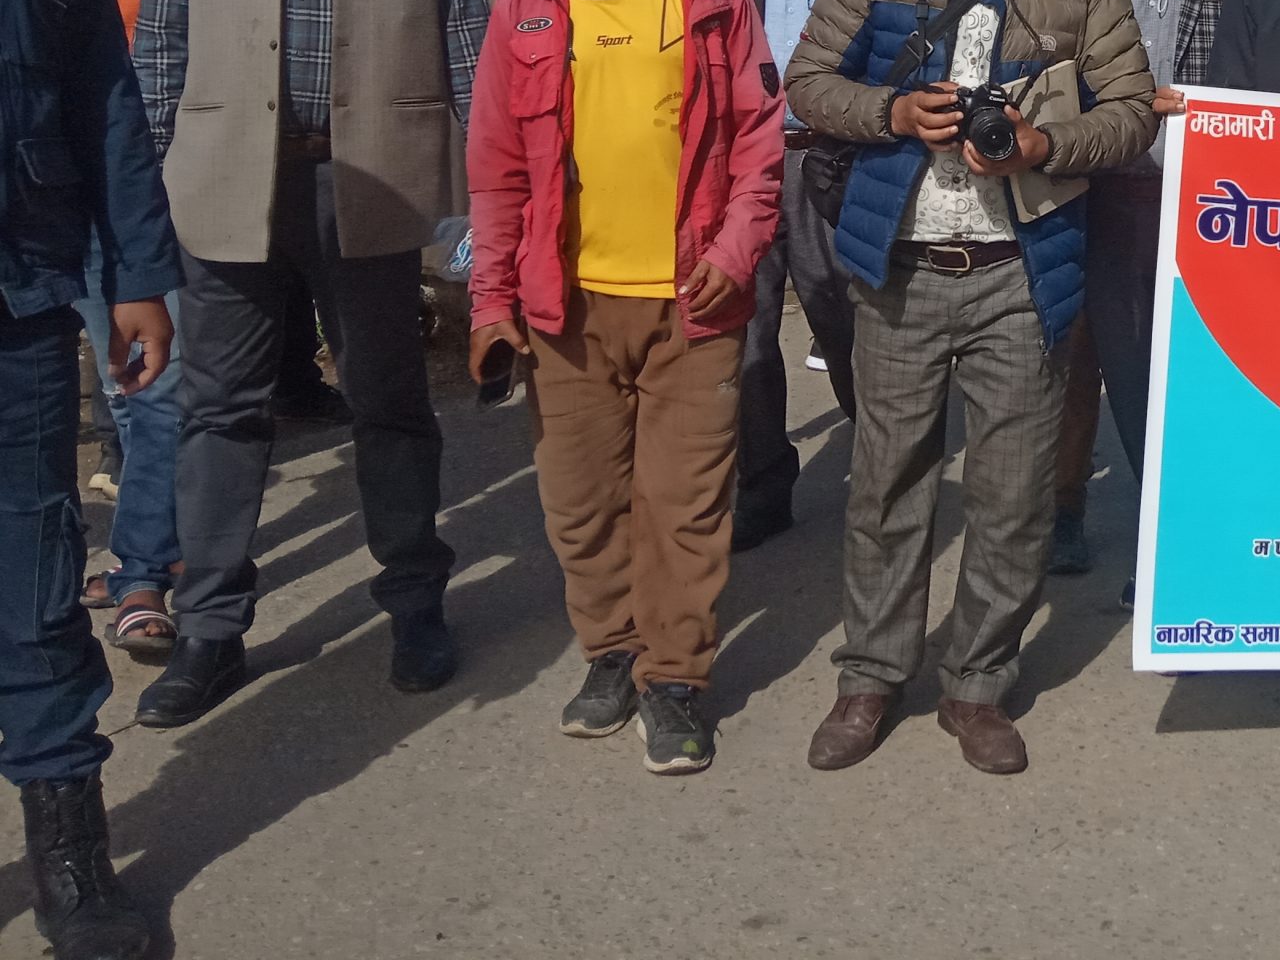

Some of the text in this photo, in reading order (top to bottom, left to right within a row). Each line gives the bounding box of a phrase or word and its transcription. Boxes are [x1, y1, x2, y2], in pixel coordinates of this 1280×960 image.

[596, 35, 633, 48] Sport
[1190, 110, 1275, 140] महामारी
[1253, 539, 1272, 557] म
[1155, 619, 1236, 645] नागरिक
